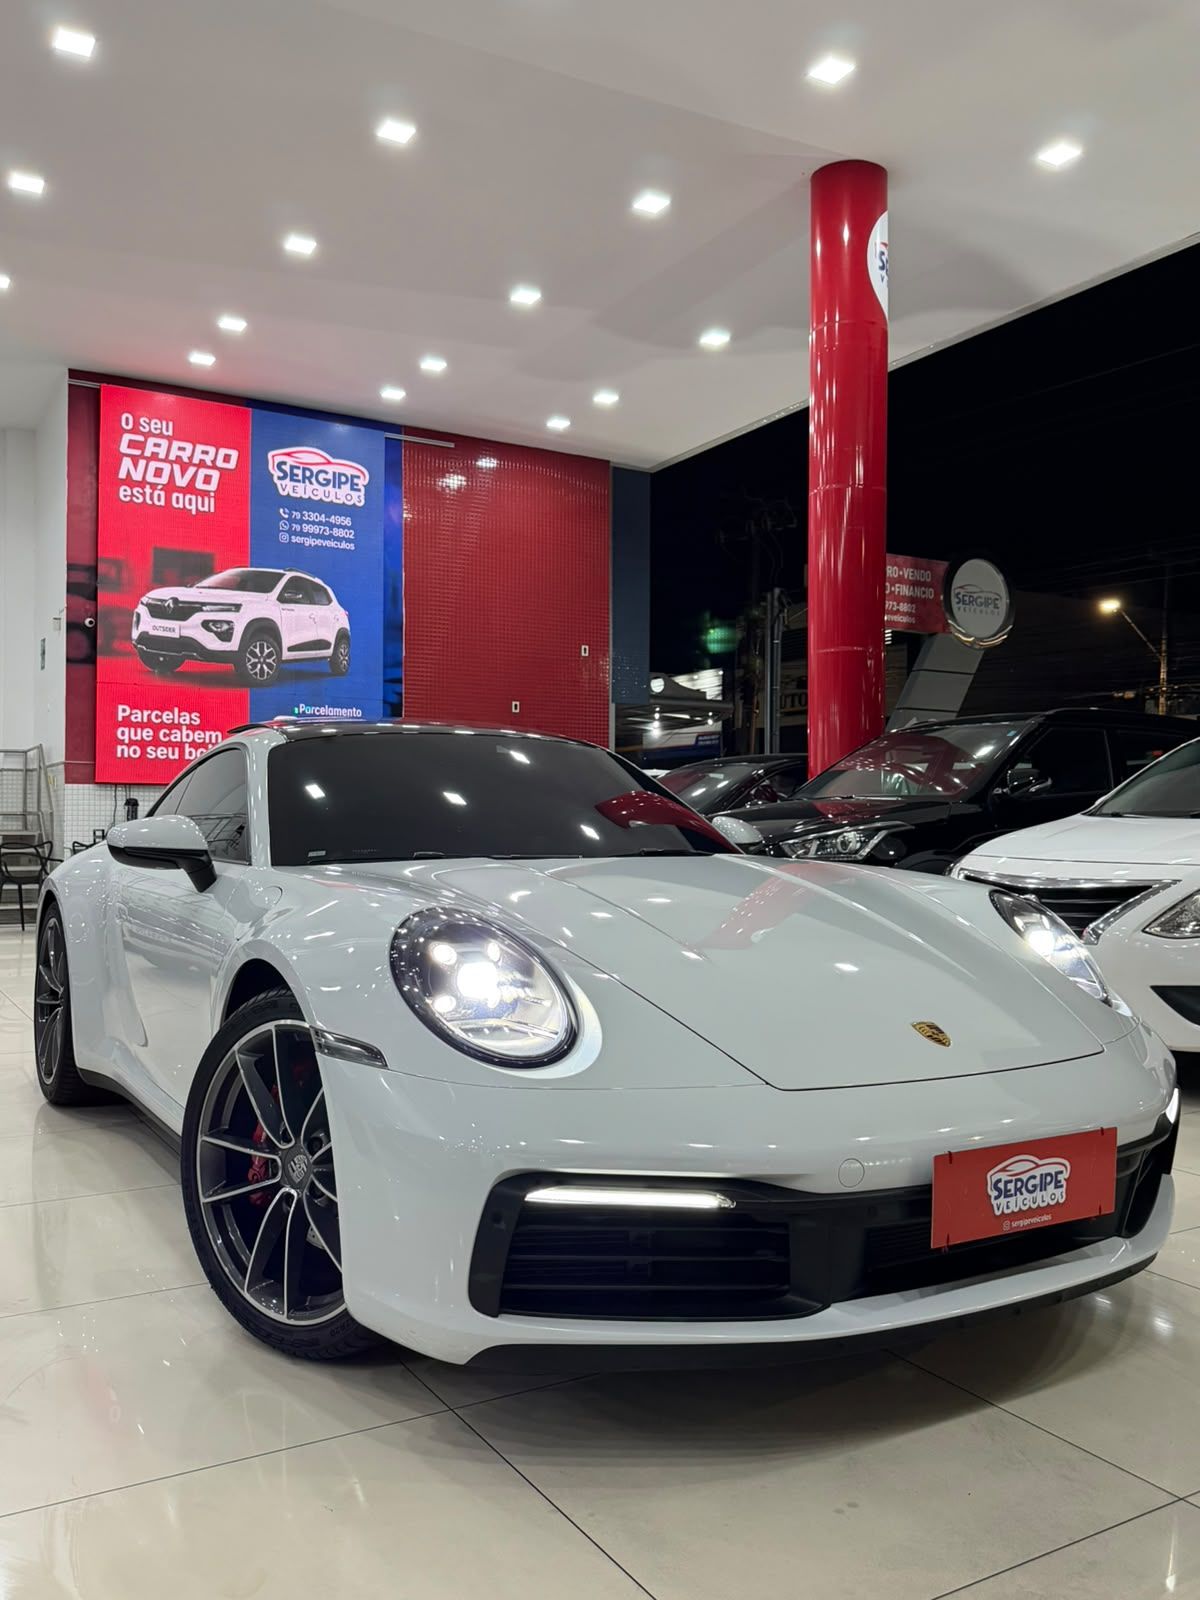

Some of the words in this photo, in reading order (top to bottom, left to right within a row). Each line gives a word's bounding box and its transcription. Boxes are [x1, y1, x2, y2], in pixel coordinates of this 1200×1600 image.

[139, 417, 174, 436] seu
[119, 433, 239, 470] CARRO
[118, 456, 221, 492] NOVO
[276, 461, 362, 493] SERGIPE
[119, 484, 166, 506] está
[172, 492, 215, 516] aqui
[291, 510, 301, 519] 79
[302, 511, 352, 527] 3304-4956
[291, 523, 301, 532] 79
[302, 523, 355, 539] 99973-8802
[291, 535, 355, 550] sergipeveiculos
[955, 592, 1000, 610] SERGIPE
[117, 704, 201, 726] Parcelas
[299, 703, 362, 717] Parcelamento
[116, 726, 154, 744] que
[159, 725, 223, 744] cabem
[116, 744, 141, 758] no
[146, 745, 180, 760] seu
[993, 1170, 1064, 1201] SERGIPE
